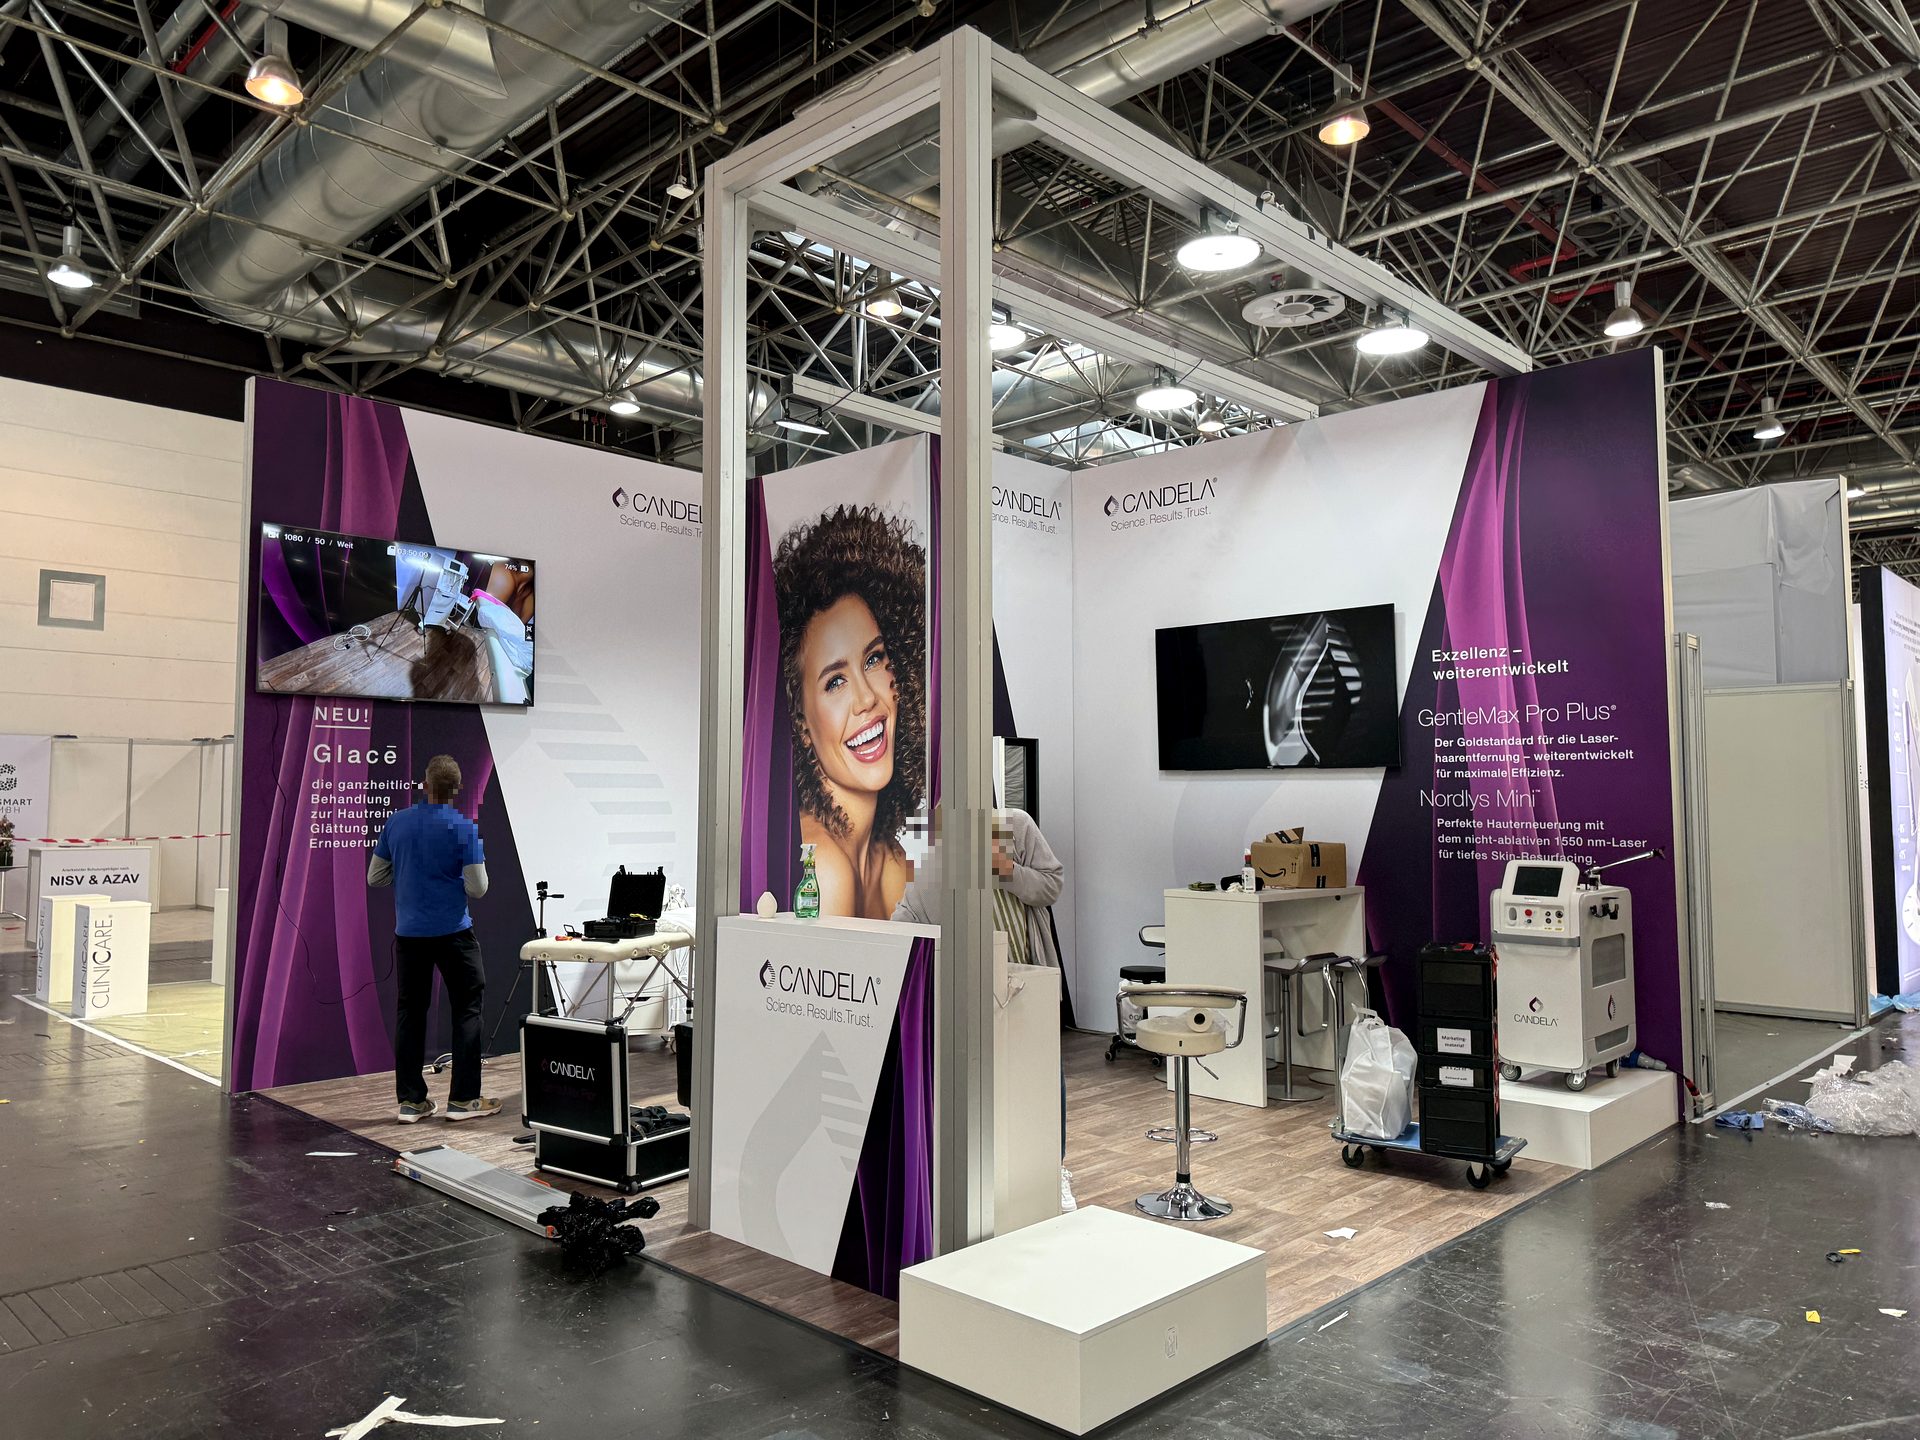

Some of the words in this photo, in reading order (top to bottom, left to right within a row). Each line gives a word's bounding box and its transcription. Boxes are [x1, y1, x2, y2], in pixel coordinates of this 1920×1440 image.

[284, 534, 303, 542] 1080
[337, 541, 353, 549] Weit
[1432, 647, 1508, 662] Exzellenz
[1433, 659, 1569, 681] weiterentwickelt
[315, 706, 369, 722] NEU!
[1418, 706, 1520, 727] GentleMax
[1526, 704, 1560, 723] Pro
[1435, 738, 1454, 747] Der
[1457, 736, 1534, 747] Goldstandard
[1538, 735, 1554, 744] für
[1558, 734, 1576, 744] die
[1580, 734, 1619, 744] Laser-
[1435, 753, 1520, 764] haarentfernung
[1534, 750, 1634, 761] weiterentwickelt
[1436, 769, 1451, 778] für
[1455, 768, 1507, 778] maximale
[1512, 767, 1565, 778] Effizienz.
[312, 779, 333, 789] die
[311, 794, 390, 806] Behandlung
[1420, 789, 1490, 811] Nordlys
[311, 811, 332, 819] zur
[310, 823, 368, 835] Glättung
[1437, 818, 1483, 828] Perfekte
[1487, 819, 1581, 832] Hauterneuerung
[1585, 820, 1604, 830] mit
[1438, 834, 1461, 843] dem
[1465, 834, 1550, 846] nicht-ablativen
[1555, 836, 1583, 846] 1550
[1587, 837, 1647, 848] nm-Laser
[1439, 849, 1454, 859] für
[1457, 850, 1488, 860] tiefes
[50, 875, 85, 886] NISV
[88, 875, 98, 885] &
[102, 874, 140, 884] AZAV
[766, 996, 806, 1016] Science.
